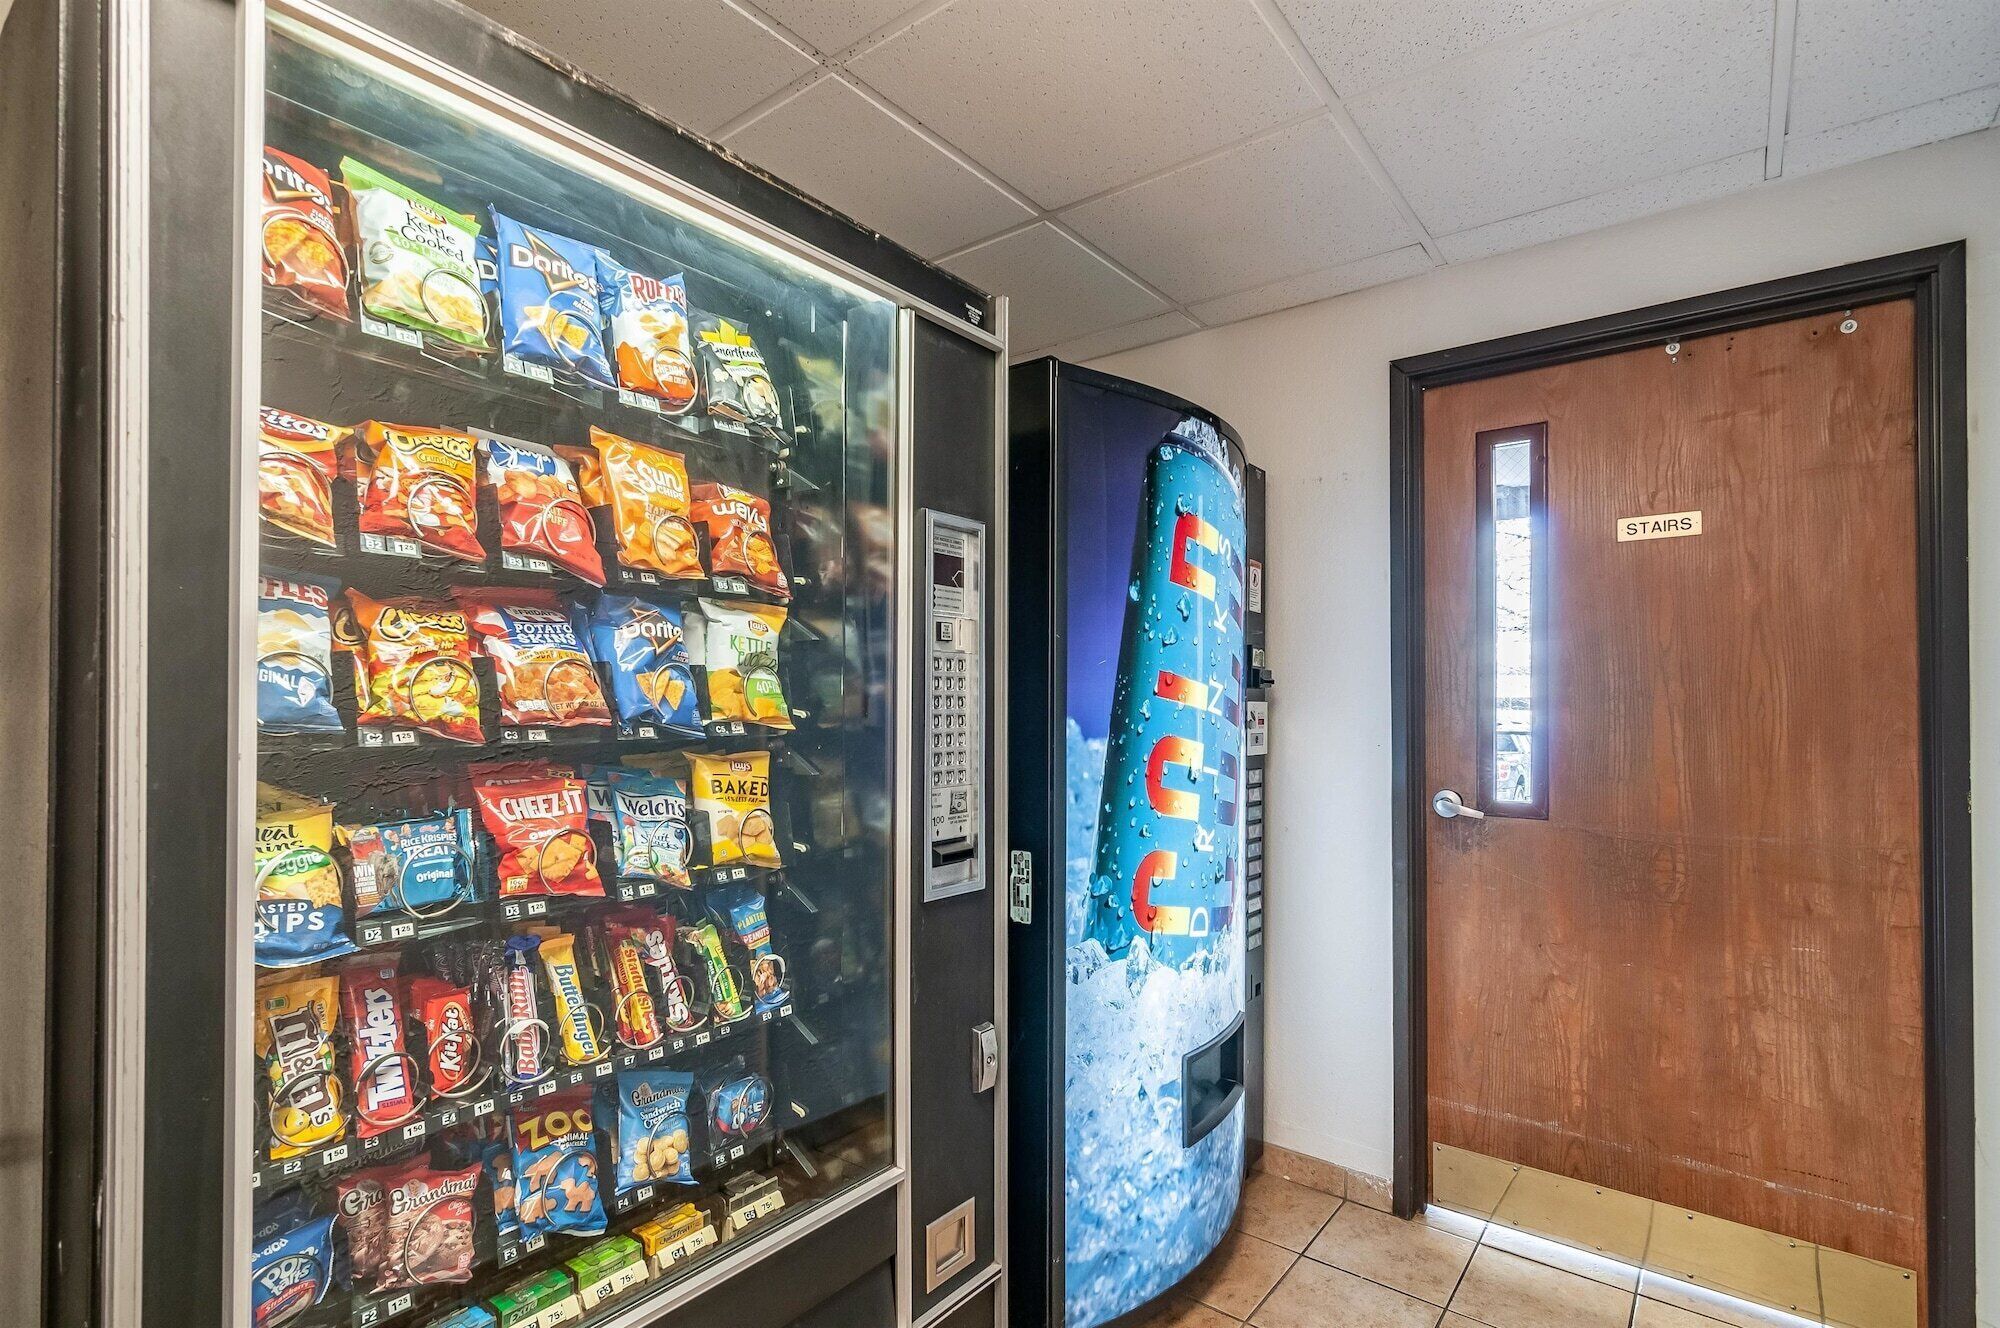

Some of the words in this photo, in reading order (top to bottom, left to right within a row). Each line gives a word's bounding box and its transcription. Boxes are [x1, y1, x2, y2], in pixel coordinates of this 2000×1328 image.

[262, 158, 333, 216] oritos
[405, 211, 456, 245] Kettle
[401, 226, 464, 262] Cooked
[510, 243, 597, 299] Doritos
[416, 451, 458, 469] Crunchy
[636, 458, 684, 494] Sun
[656, 485, 685, 503] CHIPS
[1627, 517, 1692, 536] STAIRS
[366, 540, 383, 550] B2
[508, 557, 522, 568] B3
[622, 571, 634, 580] B4
[261, 577, 329, 609] FLES
[514, 622, 573, 634] POTATO
[515, 632, 577, 646] SKINS
[730, 634, 773, 656] KETTLE
[258, 667, 299, 690] GINAL
[367, 733, 383, 743] C2
[504, 731, 518, 740] C3
[1188, 532, 1233, 939] DRINKS
[711, 779, 769, 797] BAKED
[499, 789, 584, 821] CHEEZ-IT
[620, 797, 686, 818] Welch's
[400, 838, 421, 849] RICE
[420, 832, 458, 844] KRISPIES
[353, 864, 376, 878] WIN
[415, 868, 454, 883] Original
[717, 872, 728, 881] D5
[622, 888, 634, 898] D4
[259, 902, 308, 914] ASTED
[506, 907, 520, 917] D3
[255, 912, 325, 934] IPS
[364, 929, 381, 941] D2
[743, 926, 770, 943] PEANUTS
[508, 965, 531, 1020] Ruth
[720, 1025, 731, 1036] E9
[673, 1039, 684, 1050] E8
[624, 1056, 635, 1066] E7
[571, 1073, 583, 1084] E6
[510, 1093, 524, 1104] E5
[640, 1099, 681, 1121] Sandwich
[442, 1113, 457, 1126] E4
[518, 1108, 594, 1150] ZOO
[365, 1136, 380, 1149] E3
[284, 1161, 302, 1175] E2
[618, 1198, 629, 1210] F4
[503, 1247, 518, 1261] F3
[673, 1249, 685, 1260] G4
[596, 1284, 611, 1298] G3
[361, 1309, 378, 1324] F2
